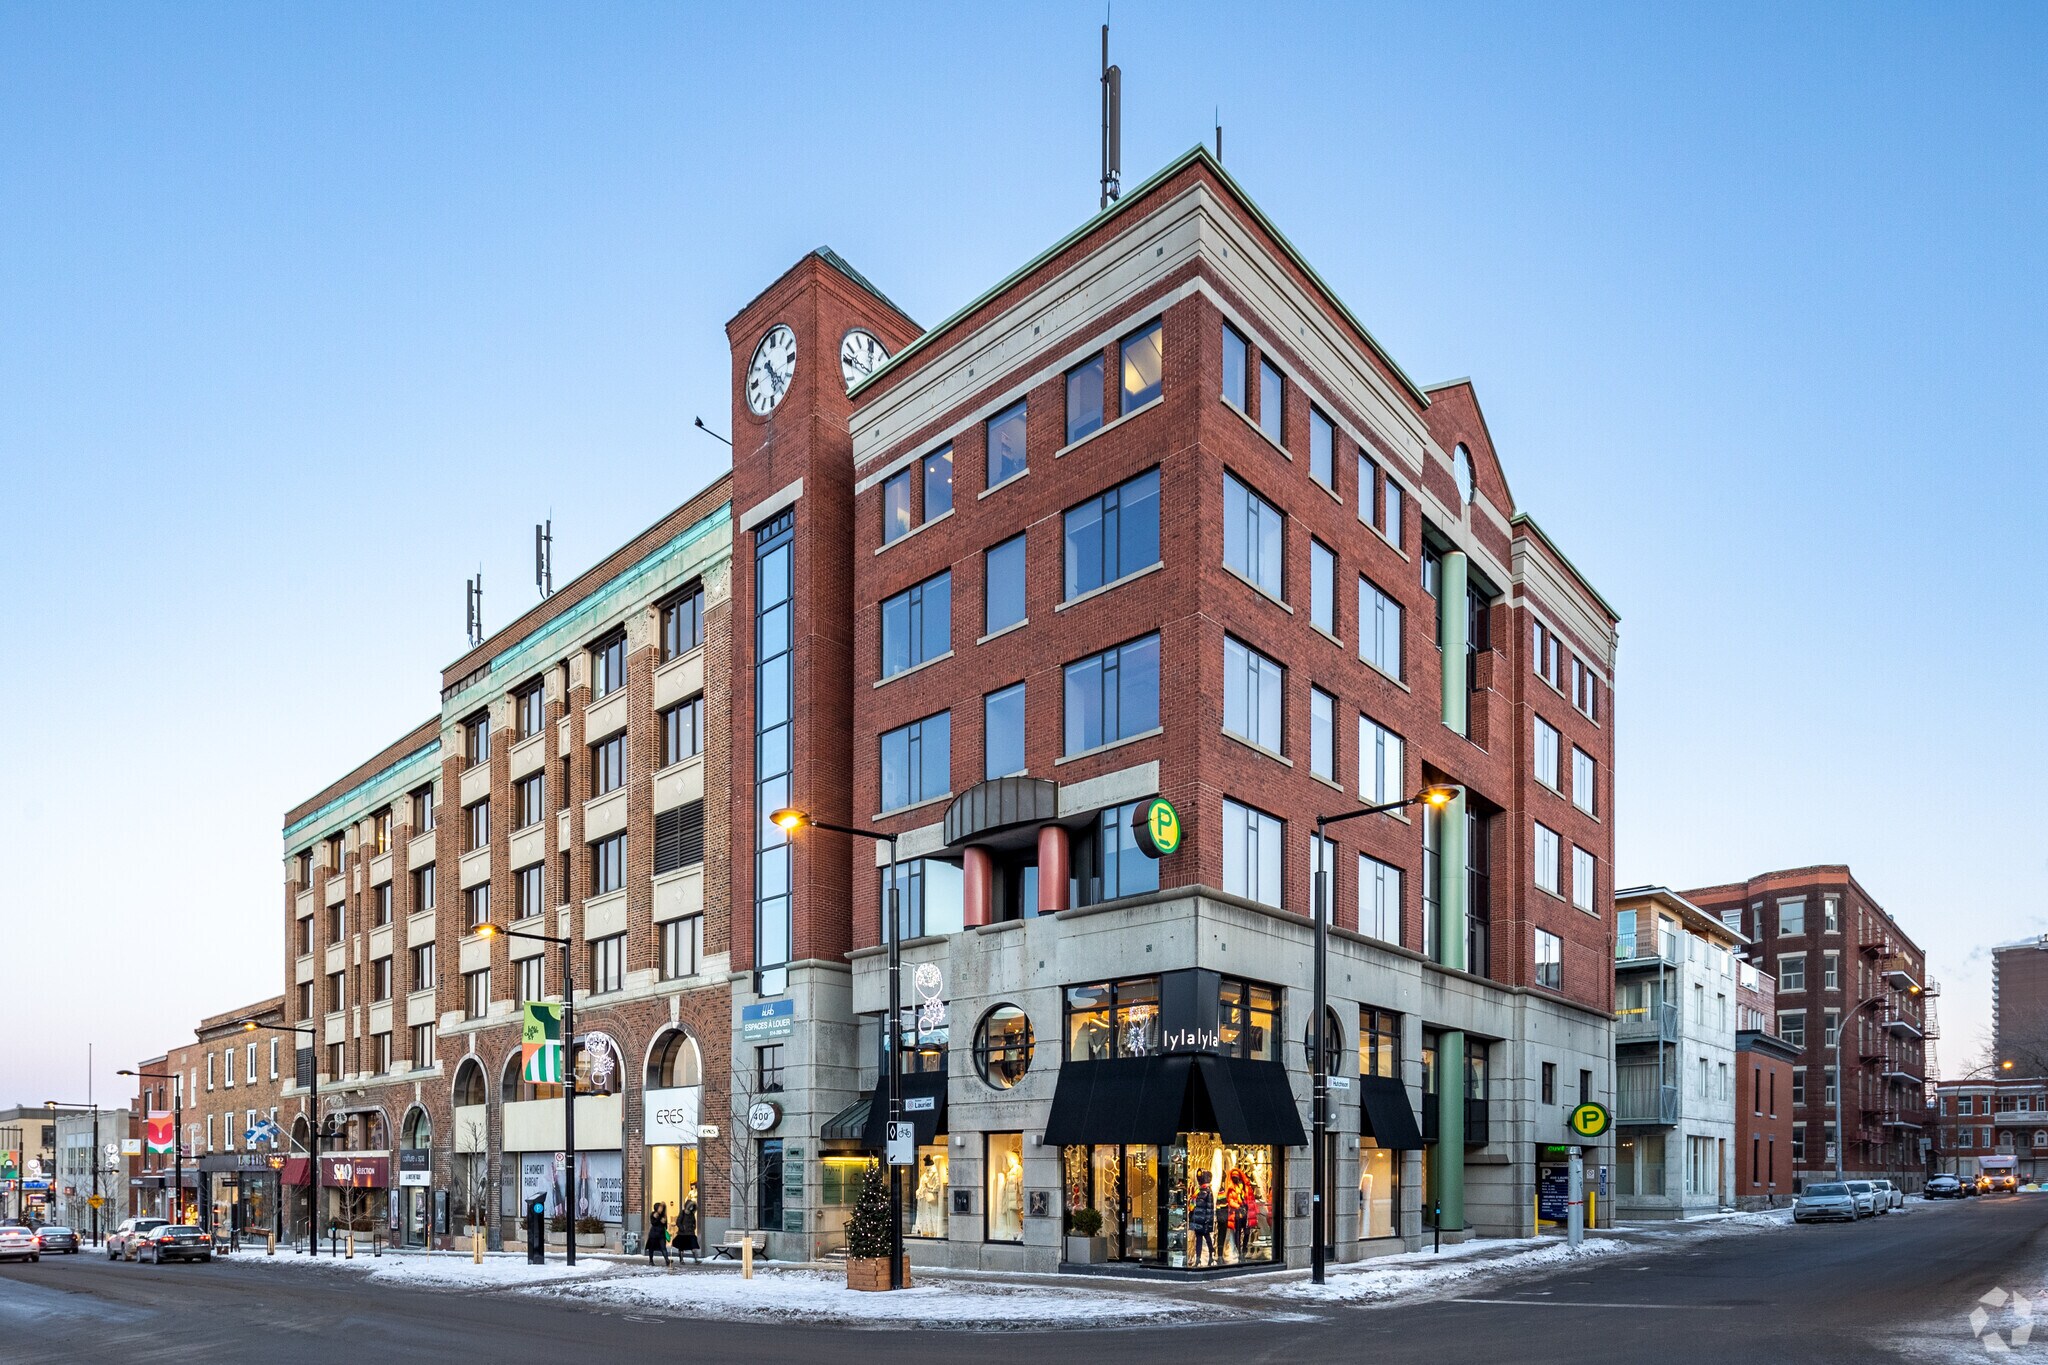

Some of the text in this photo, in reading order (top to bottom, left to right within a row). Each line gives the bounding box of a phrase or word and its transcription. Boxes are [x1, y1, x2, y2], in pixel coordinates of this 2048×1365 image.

[1157, 806, 1172, 836] P
[744, 1018, 791, 1031] ESPACES À LOUER
[656, 1108, 684, 1125] ERES
[1582, 1110, 1600, 1129] P
[333, 1163, 353, 1181] SAQ
[524, 1164, 529, 1174] LE
[529, 1164, 544, 1174] MOMENT
[524, 1177, 539, 1187] PARFAIT
[596, 1177, 608, 1188] POUR
[601, 1191, 609, 1202] DES
